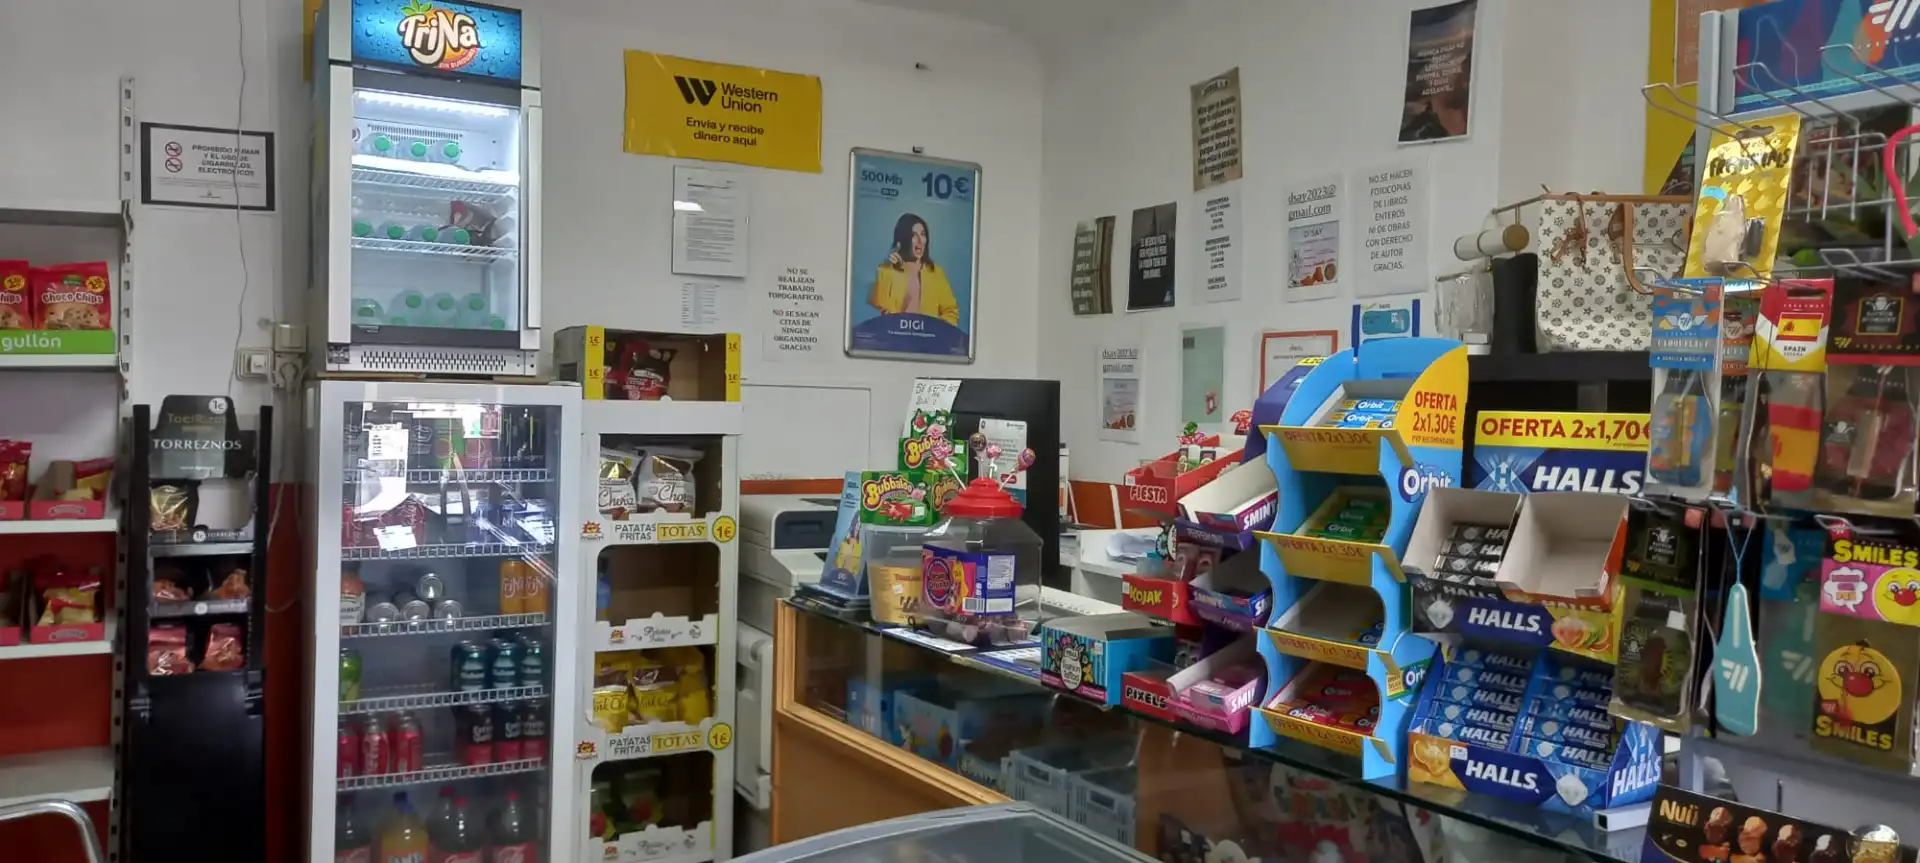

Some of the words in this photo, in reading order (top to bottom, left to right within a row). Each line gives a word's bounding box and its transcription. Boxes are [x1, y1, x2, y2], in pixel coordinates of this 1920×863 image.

[721, 81, 778, 102] Western
[721, 95, 762, 113] Union
[719, 123, 726, 131] y
[728, 122, 765, 136] recibe
[693, 130, 731, 143] dinero
[192, 144, 233, 153] PROHIBIDO
[861, 170, 884, 182] 500
[884, 174, 903, 185] Mb
[1369, 175, 1379, 184] NO
[1380, 172, 1388, 181] SE
[1389, 169, 1413, 180] HACEN
[922, 171, 970, 199] 10€
[1370, 181, 1411, 197] FOTOCOPIAS
[1288, 184, 1336, 204] dsay2023@
[1373, 199, 1382, 209] DE
[1383, 196, 1408, 208] LIBROS
[1288, 204, 1331, 221] gmail.com
[1375, 208, 1405, 221] ENTEROS
[1368, 226, 1376, 235] NI
[1377, 224, 1386, 234] DE
[1387, 221, 1411, 232] OBRAS
[1365, 239, 1380, 248] CON
[1381, 233, 1414, 246] DERECHO
[1370, 251, 1380, 260] DE
[1381, 248, 1403, 258] AUTOR
[786, 267, 798, 275] NO
[799, 267, 808, 275] SE
[778, 276, 815, 284] REALIZAN
[778, 284, 815, 292] TRABAJOS
[0, 291, 22, 303] hips
[41, 291, 74, 304] Choco
[74, 291, 104, 305] Chips
[768, 292, 823, 301] TOPOGRAFICOS
[772, 309, 784, 317] NO
[781, 327, 810, 335] NINGUN
[900, 319, 924, 330] DIGI
[2, 332, 62, 352] gullón
[589, 336, 600, 345] 1€
[728, 342, 738, 350] 1€
[773, 335, 818, 343] ORGANISMO
[589, 368, 599, 377] 1€
[728, 373, 737, 381] 1€
[212, 399, 224, 410] 1€
[1358, 401, 1384, 409] Orbit
[1414, 390, 1457, 411] OFERTA
[1347, 413, 1373, 422] Orbit
[1413, 411, 1456, 434] 2x1.30€
[1481, 417, 1566, 439] OFERTA
[152, 438, 242, 450] TORREZNOS
[1284, 431, 1326, 443] OFERTA
[1327, 431, 1371, 444] 2x1.30€
[1403, 464, 1451, 495] Orbit
[865, 477, 913, 506] Bubbaloo
[1130, 485, 1167, 503] FIESTA
[615, 524, 656, 532] PATATAS
[660, 526, 705, 537] TOTAS
[716, 528, 733, 538] 1€
[1328, 523, 1355, 533] Orbit
[620, 532, 652, 540] FRITAS
[1833, 539, 1918, 568] SMILES
[1130, 586, 1163, 606] KOJAK
[1485, 653, 1532, 669] HALLS
[1479, 671, 1527, 688] HALLS
[1126, 686, 1168, 709] PIXELS
[1473, 689, 1522, 707] HALLS
[1289, 709, 1315, 721] Orbit
[1466, 708, 1515, 726] HALLS
[712, 732, 729, 746] 1€
[1459, 725, 1509, 744] HALLS
[1562, 726, 1610, 744] HALLS
[1815, 714, 1892, 750] SMILES
[609, 736, 651, 748] PATATAS
[656, 734, 700, 749] TOTAS
[614, 745, 646, 755] FRITAS
[1611, 755, 1662, 797] HALLS
